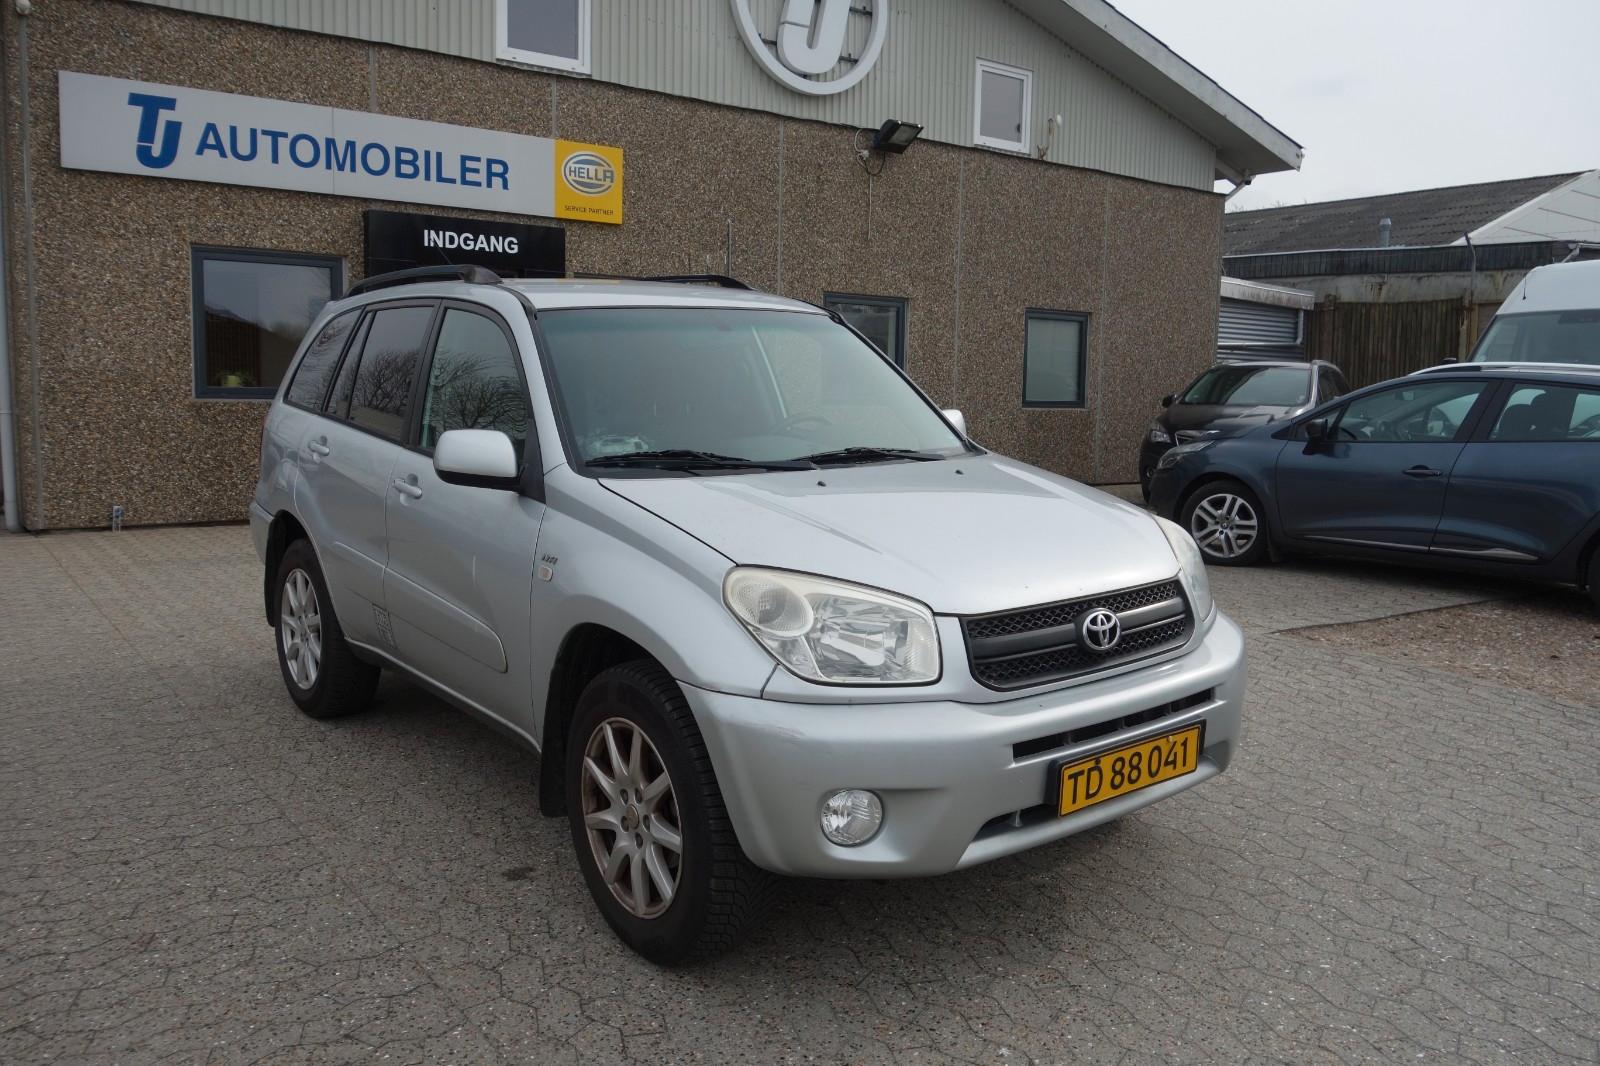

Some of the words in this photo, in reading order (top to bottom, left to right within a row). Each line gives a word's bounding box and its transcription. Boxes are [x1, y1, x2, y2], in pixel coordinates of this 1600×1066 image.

[128, 92, 182, 169] TJ
[195, 123, 510, 191] AUTOMOBILER
[569, 166, 614, 183] HELLA
[564, 205, 587, 213] SERVICE
[588, 207, 614, 216] PARTNER
[423, 229, 519, 255] INDGANG
[1067, 765, 1103, 805] TD
[1110, 751, 1143, 790] 88
[1147, 737, 1189, 778] 041
